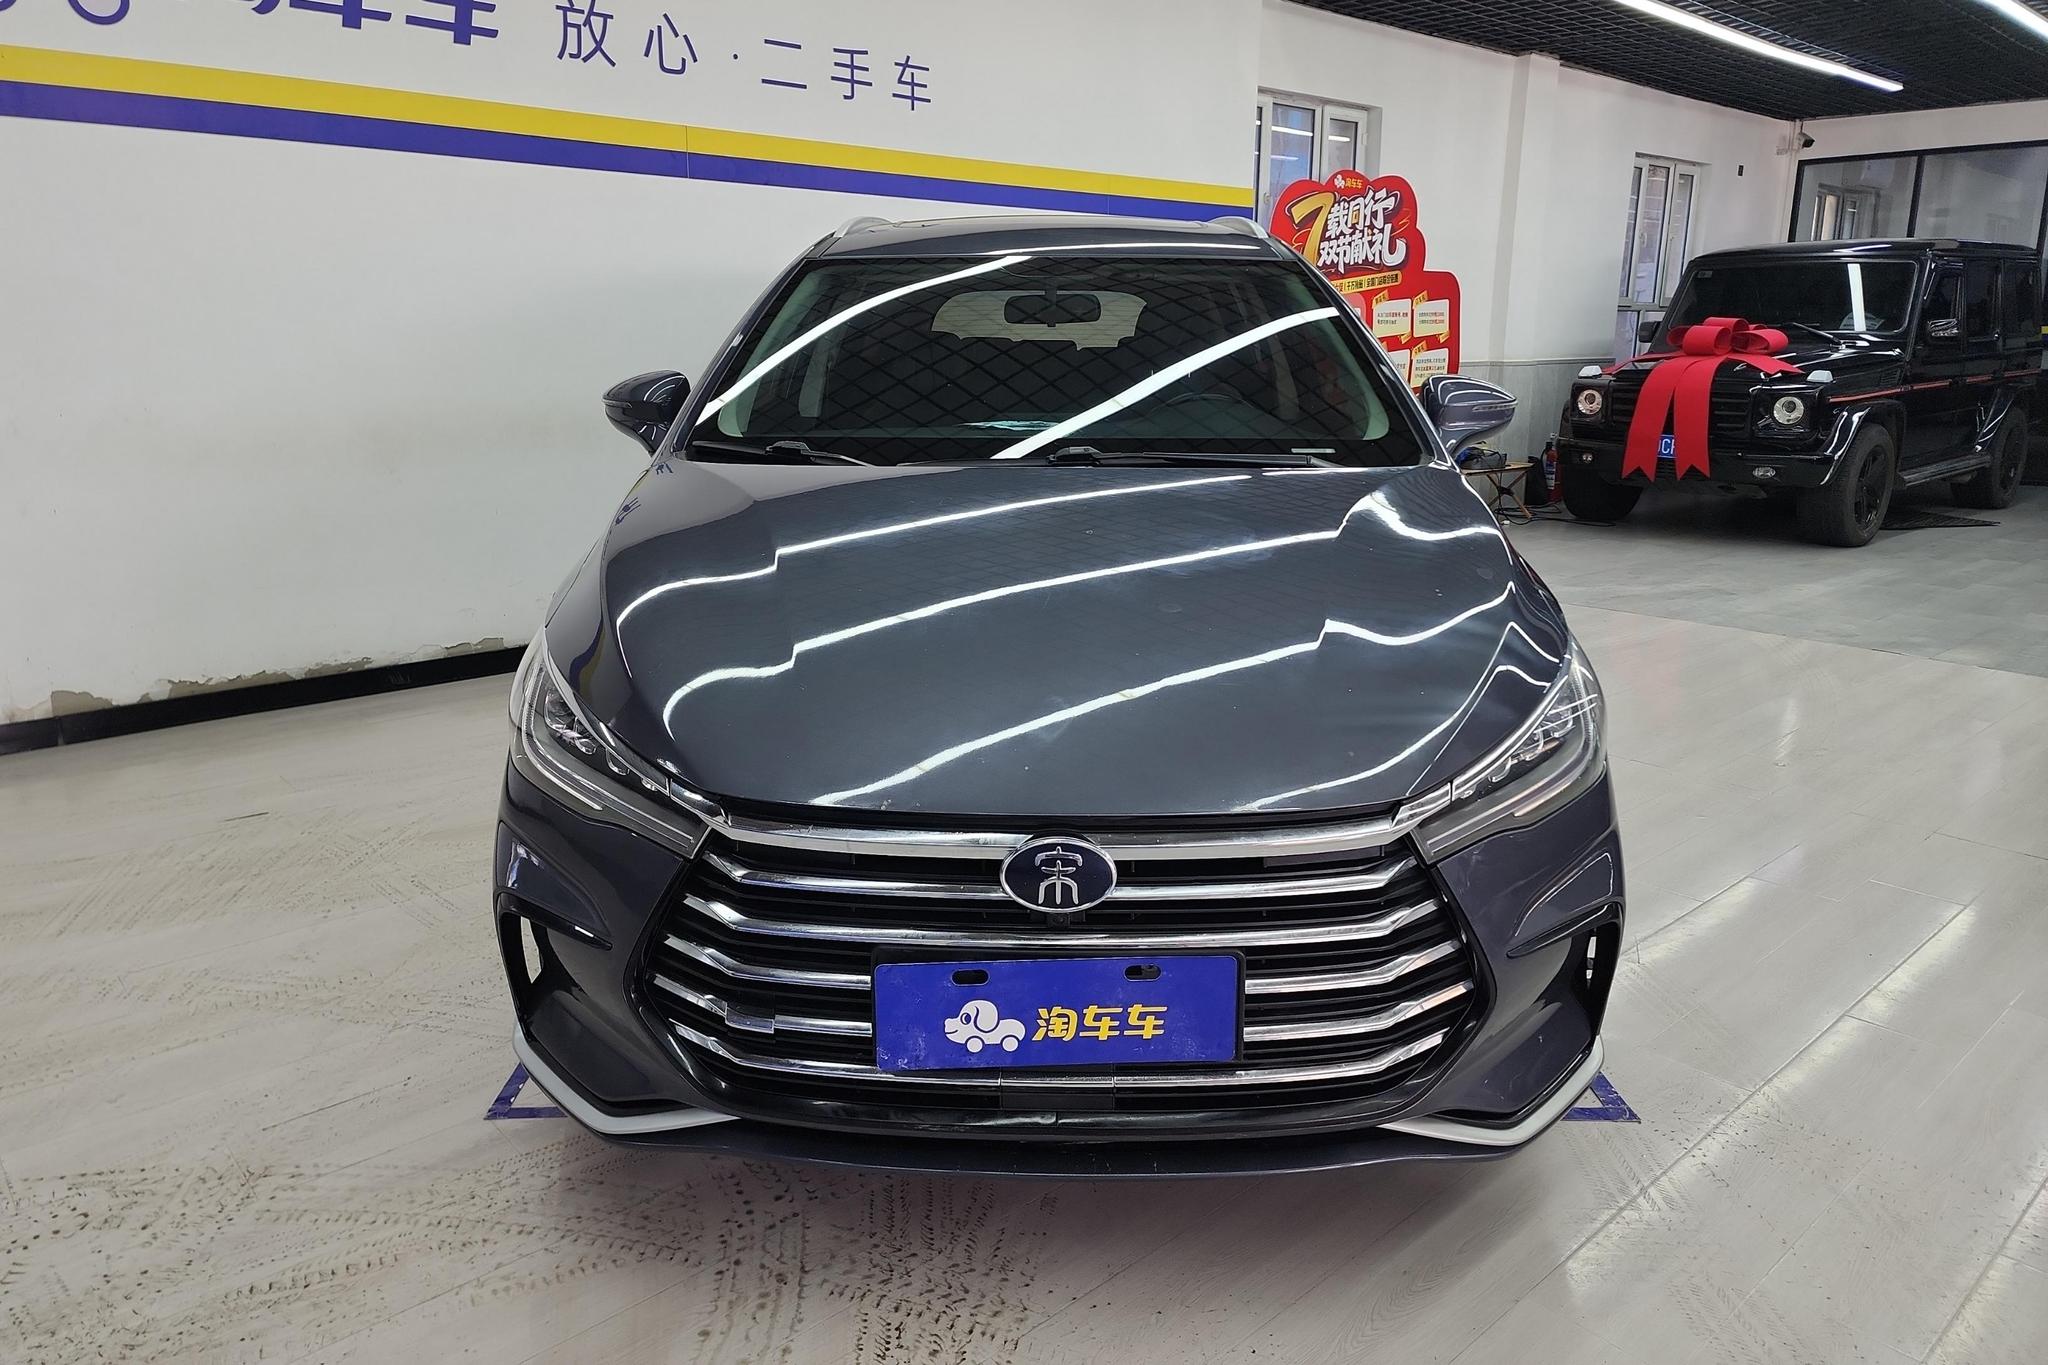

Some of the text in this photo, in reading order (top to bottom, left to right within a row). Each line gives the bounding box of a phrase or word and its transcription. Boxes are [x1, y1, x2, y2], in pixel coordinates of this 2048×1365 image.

[1317, 223, 1406, 274] 双节献礼
[1031, 1003, 1168, 1042] 淘车车
